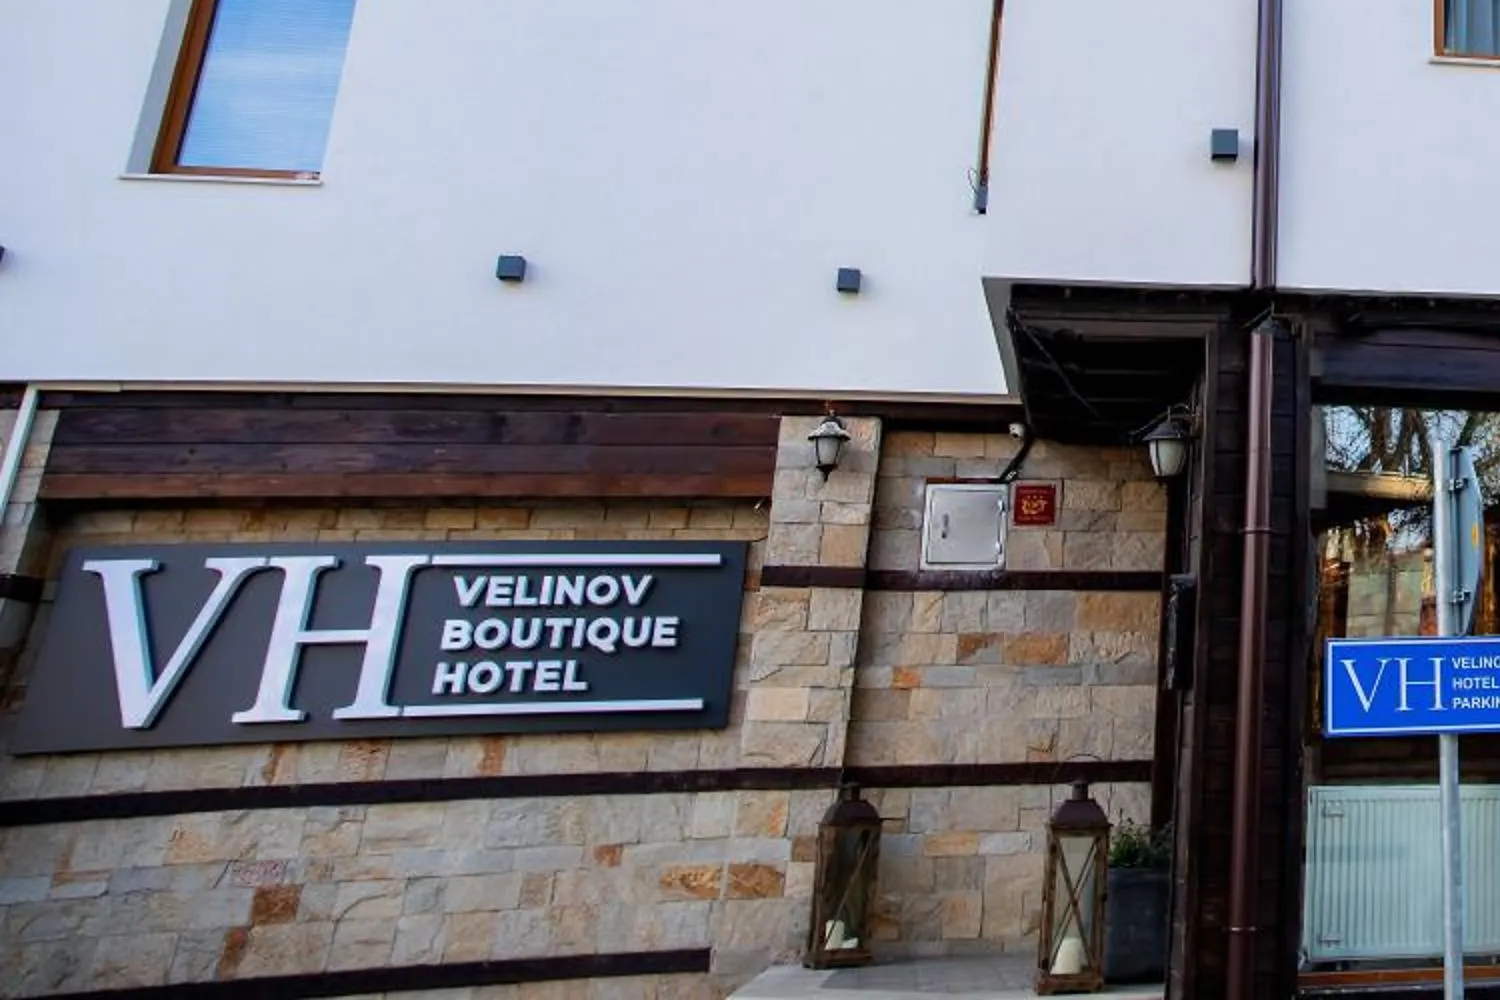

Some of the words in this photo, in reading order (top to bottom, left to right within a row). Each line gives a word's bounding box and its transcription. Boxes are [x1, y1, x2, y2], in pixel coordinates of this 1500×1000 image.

[453, 575, 652, 606] VELINOV
[83, 555, 431, 729] VH
[440, 616, 679, 652] BOUTIQUE
[431, 660, 588, 693] HOTEL
[1339, 657, 1448, 712] VH
[1452, 676, 1500, 689] HOTEL
